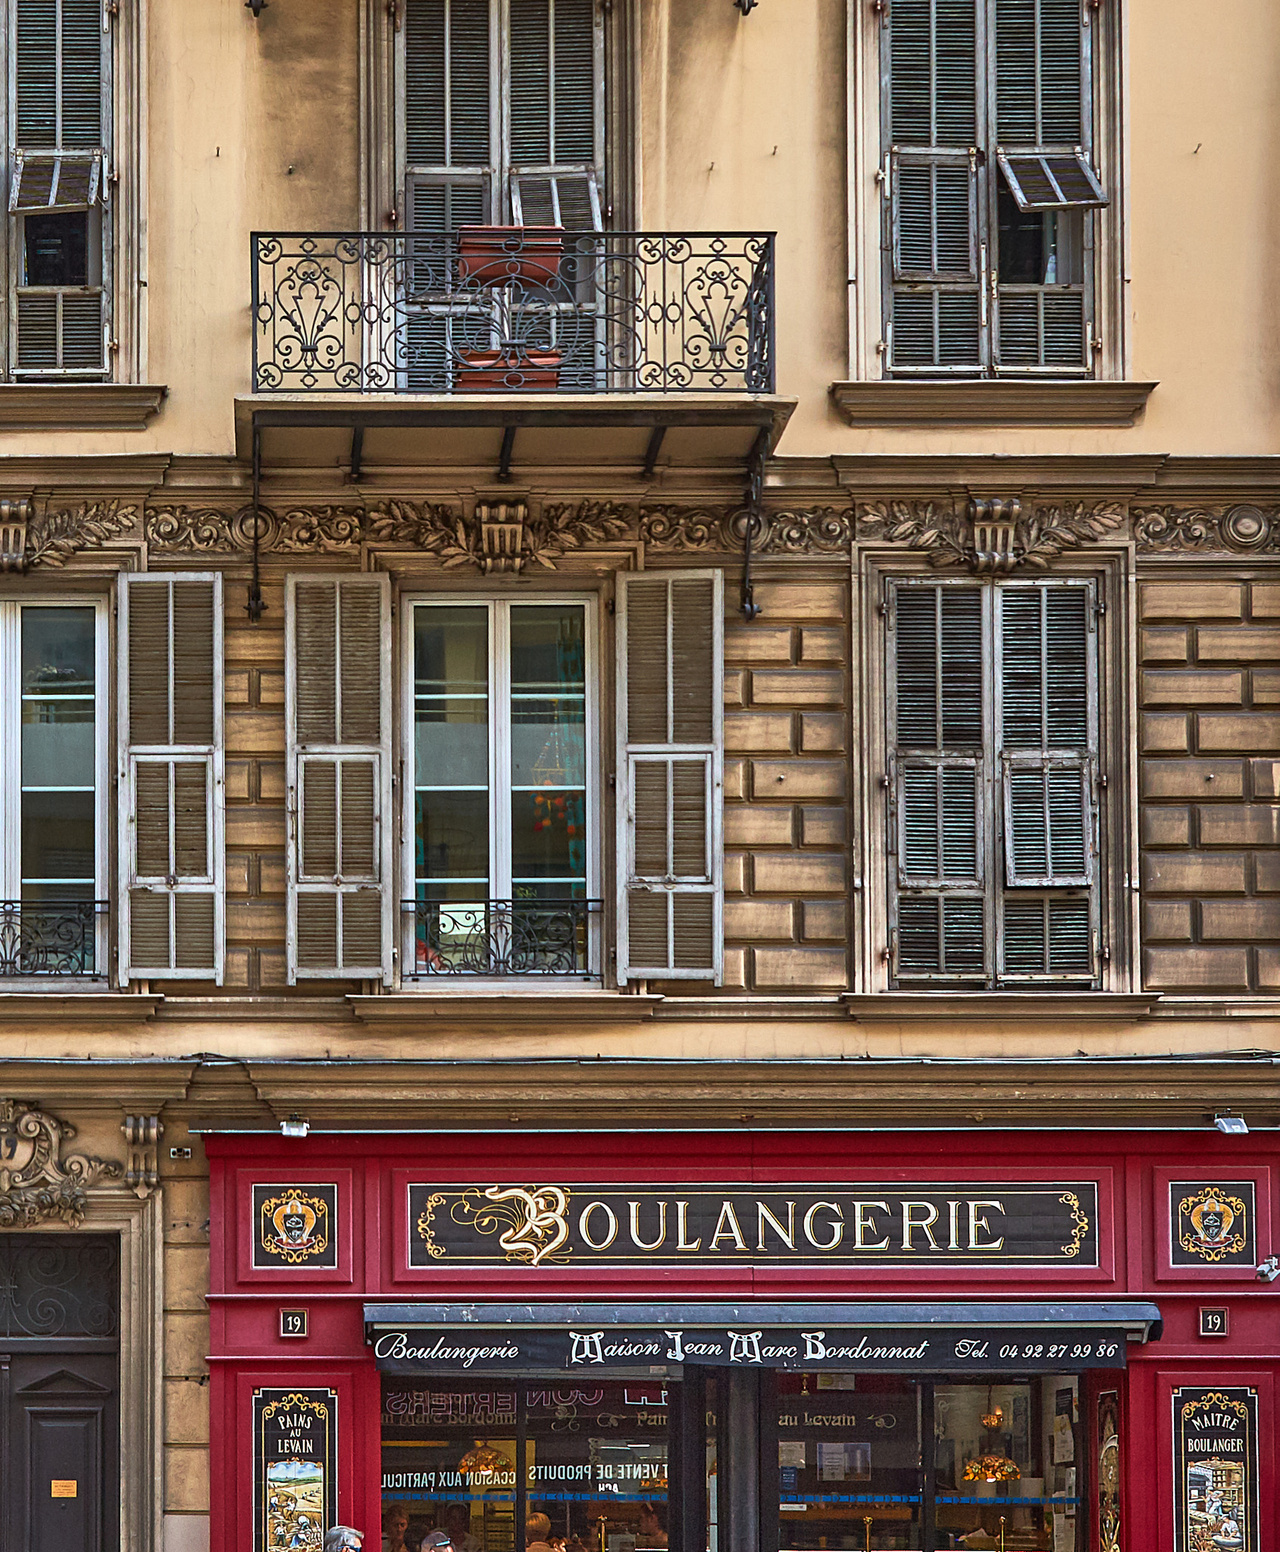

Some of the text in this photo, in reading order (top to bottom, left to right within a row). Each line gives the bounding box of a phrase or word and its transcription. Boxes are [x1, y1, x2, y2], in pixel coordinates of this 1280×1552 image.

[484, 1184, 1007, 1267] BOULANGERIE
[286, 1315, 302, 1332] 19
[1206, 1314, 1222, 1331] 19
[375, 1332, 519, 1368] Boulangerie
[569, 1331, 661, 1363] Maison
[664, 1330, 724, 1362] Jean
[727, 1331, 797, 1363] Marc
[801, 1331, 930, 1360] Bordonnat
[999, 1344, 1018, 1358] 04
[1022, 1344, 1044, 1358] 92
[1046, 1344, 1068, 1358] 27
[1070, 1344, 1092, 1358] 99
[1095, 1343, 1119, 1358] 86
[277, 1413, 313, 1430] PAINS
[778, 1411, 857, 1427] au Levain
[1191, 1412, 1239, 1431] MAITRE
[290, 1428, 302, 1438] AU
[277, 1439, 314, 1454] LEVAIN
[1187, 1438, 1244, 1453] BOULANGER
